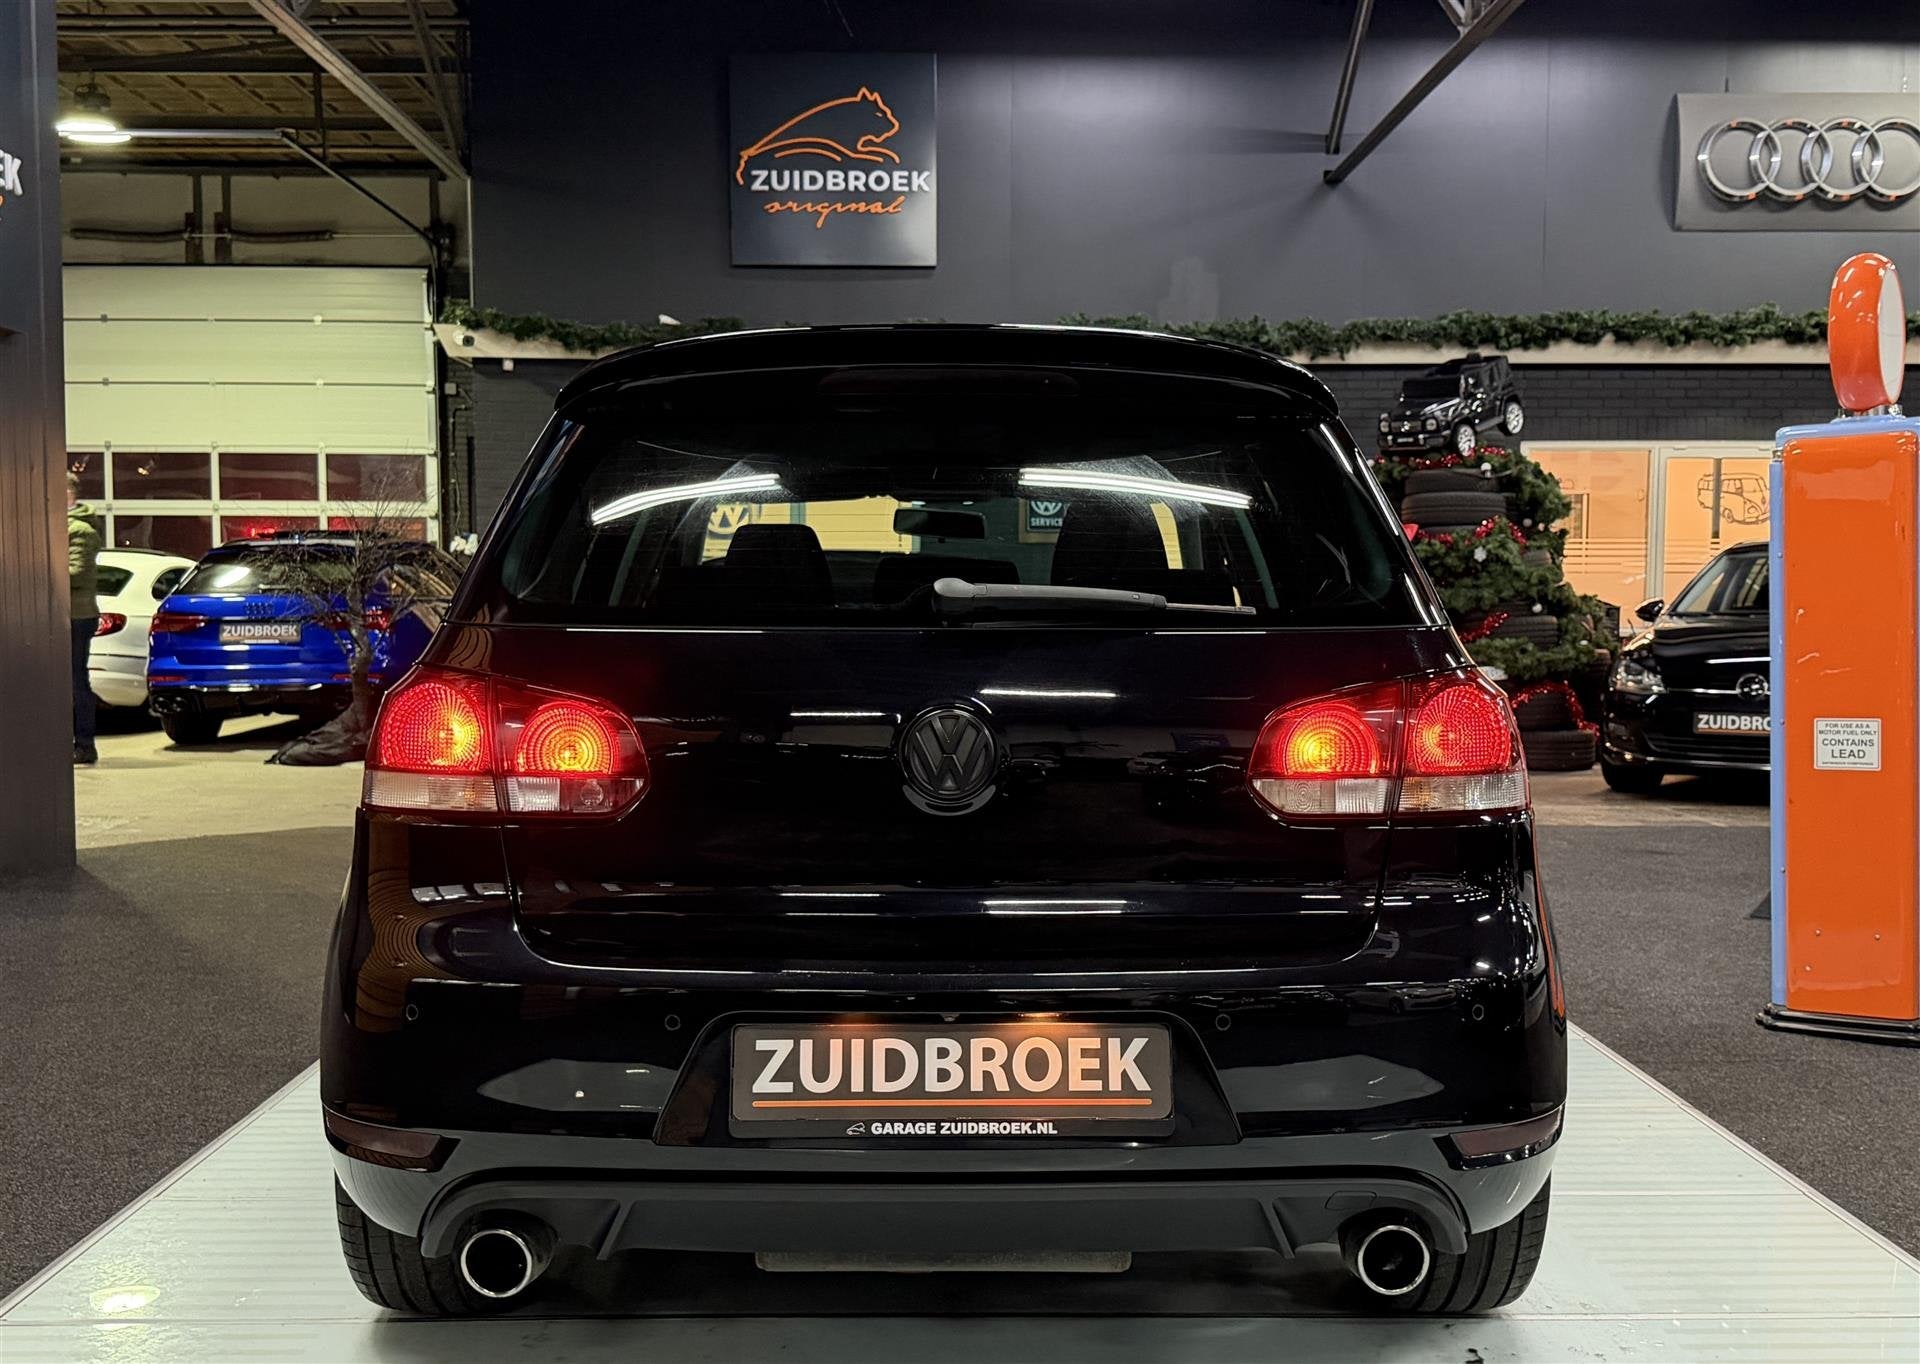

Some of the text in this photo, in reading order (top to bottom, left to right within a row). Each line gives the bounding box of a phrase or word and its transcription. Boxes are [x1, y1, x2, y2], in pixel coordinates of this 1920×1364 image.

[750, 169, 931, 192] ZUIDBROEK
[764, 195, 905, 229] original
[1031, 517, 1063, 527] SERVICE
[223, 625, 297, 637] ZUIDBROEK
[1822, 738, 1875, 747] CONTAINS
[1831, 749, 1866, 759] LEAD
[751, 1037, 1152, 1094] ZUIDBROEK
[871, 1122, 1058, 1134] GARAGE ZUIDBROEK.NL
